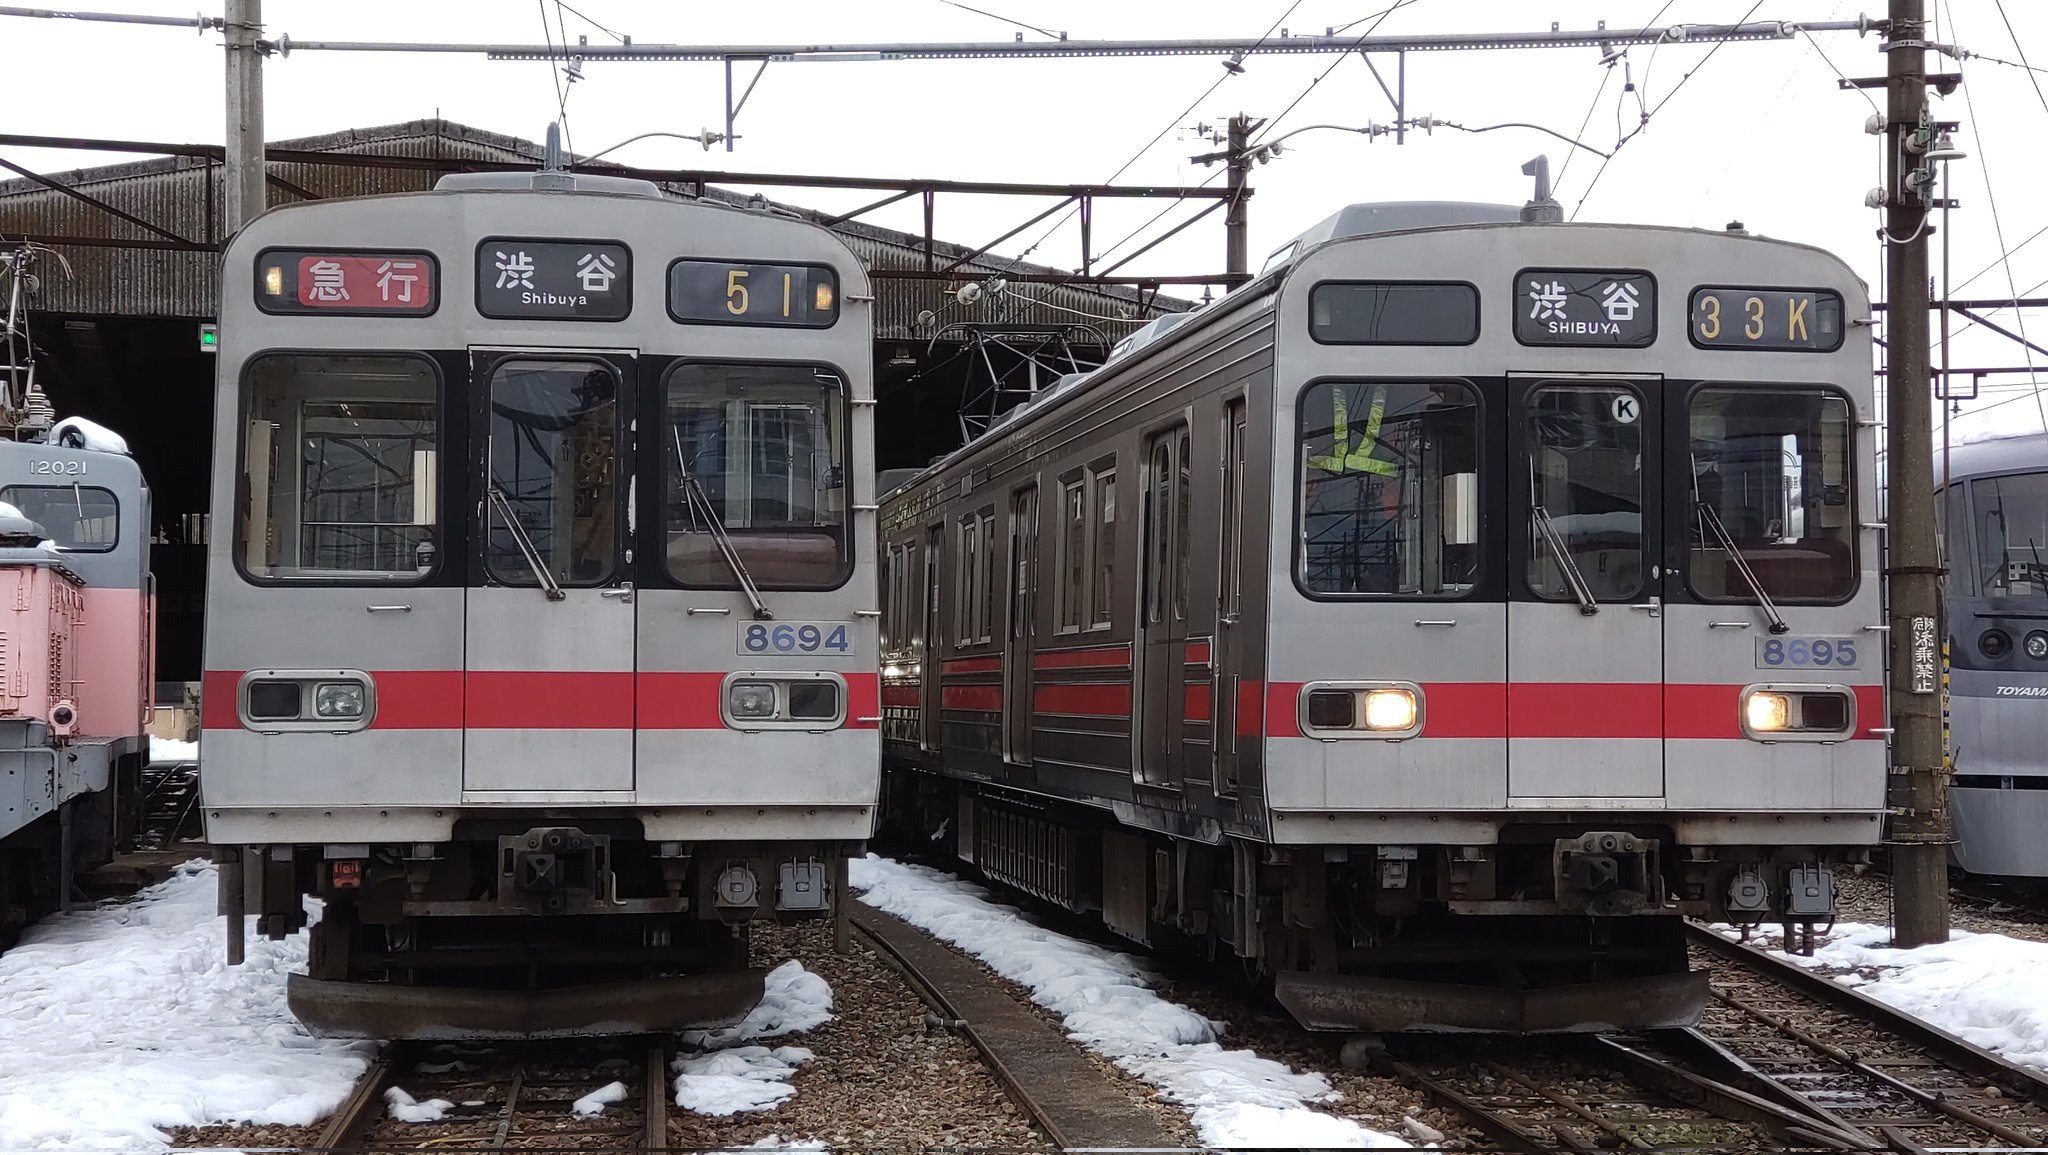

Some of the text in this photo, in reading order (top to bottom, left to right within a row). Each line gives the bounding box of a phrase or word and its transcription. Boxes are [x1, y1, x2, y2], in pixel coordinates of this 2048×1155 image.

[308, 261, 418, 302] 急行
[494, 250, 617, 292] 渋谷
[521, 291, 587, 306] Shibuya
[1529, 280, 1641, 321] 渋谷
[1548, 321, 1621, 335] SHIBUYA
[1616, 399, 1634, 418] K
[29, 460, 87, 475] 12021
[744, 624, 849, 653] 8694
[1763, 639, 1857, 666] 8695
